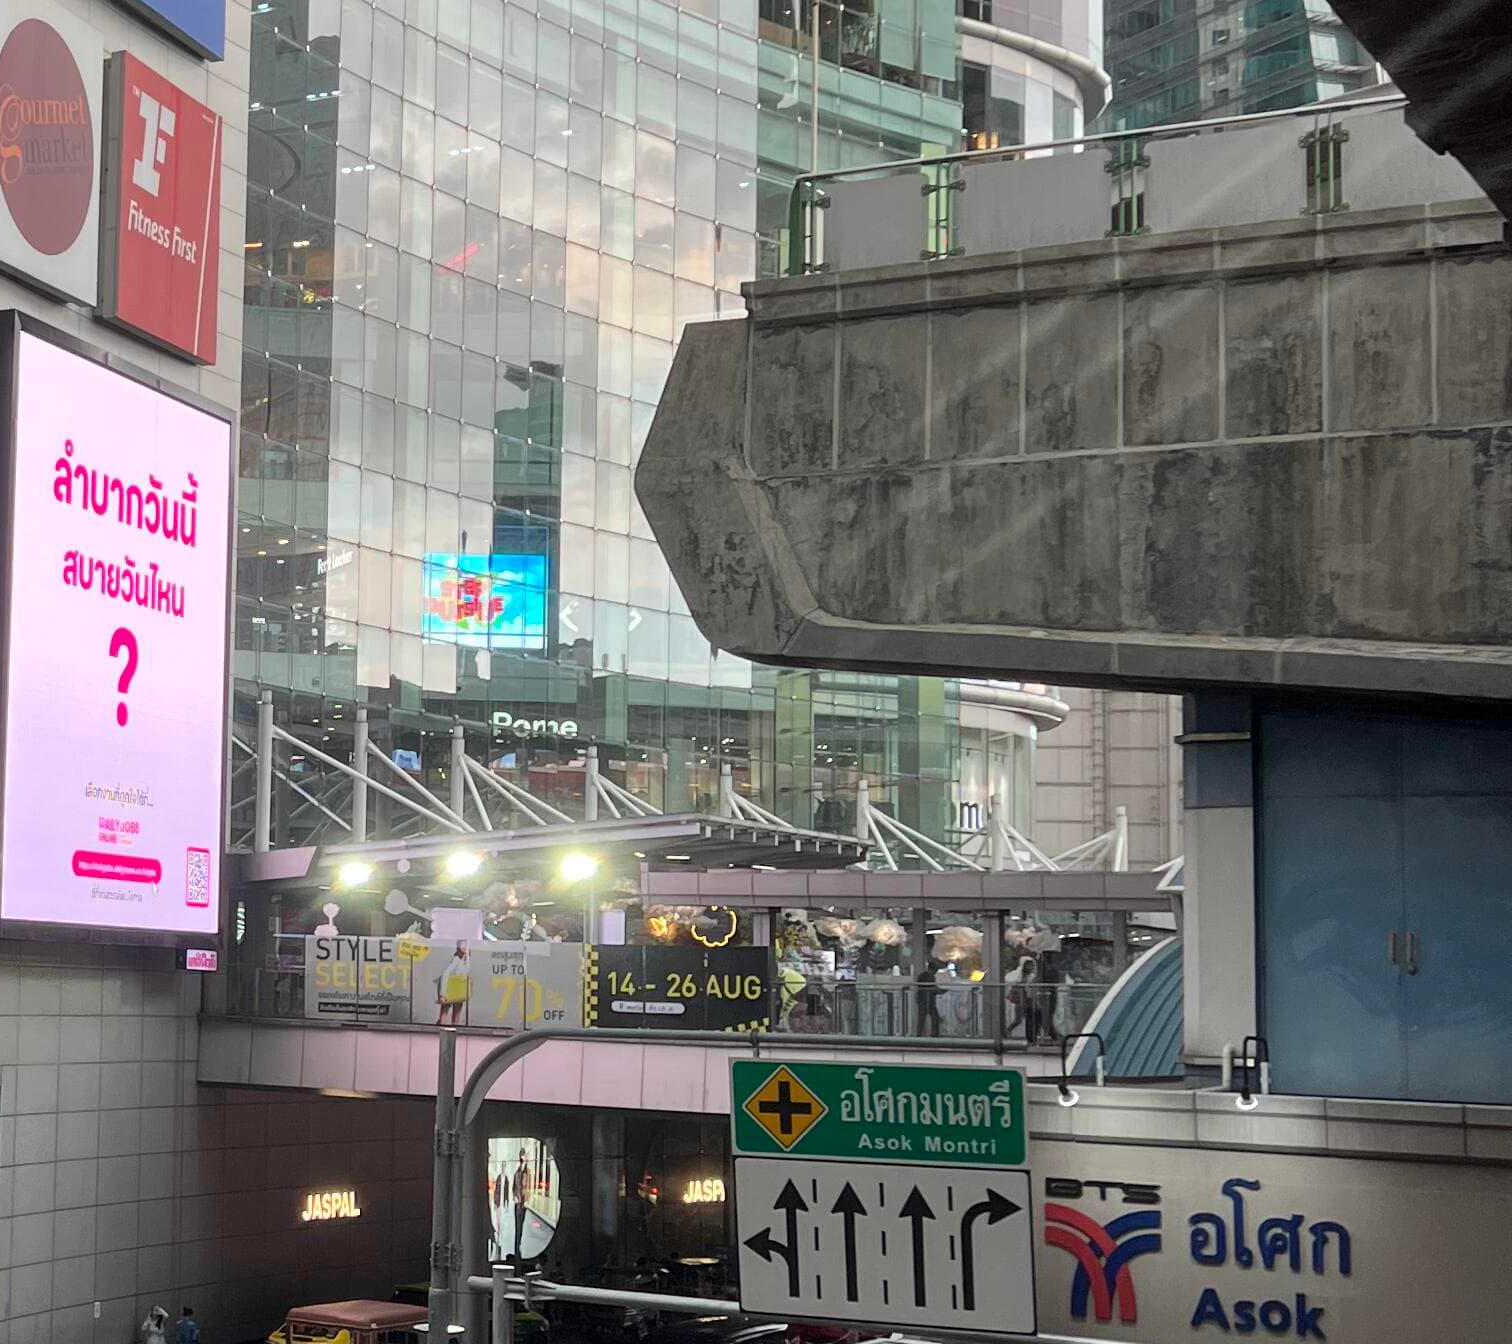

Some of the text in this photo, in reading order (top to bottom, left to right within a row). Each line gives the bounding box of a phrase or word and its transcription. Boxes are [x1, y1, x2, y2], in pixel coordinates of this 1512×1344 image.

[25, 127, 89, 163] market
[127, 199, 198, 264] Fitness First
[52, 438, 199, 548] ลำบากวันนี้
[63, 550, 185, 618] สบายวันไหน
[108, 626, 139, 727] ?
[316, 937, 393, 962] STYLE
[314, 961, 411, 990] SELECT
[492, 964, 525, 976] UP TO
[607, 971, 636, 996] 14
[666, 973, 697, 998] 26
[706, 974, 762, 1000] AUG
[543, 1009, 565, 1021] OFF
[839, 1068, 1013, 1128] อโศกมนตรี
[858, 1132, 997, 1155] Asok Montri
[301, 1191, 360, 1222] JASPAL
[1045, 1176, 1162, 1205] BTS
[1189, 1177, 1352, 1277] อโศก
[1191, 1286, 1328, 1341] Asok
